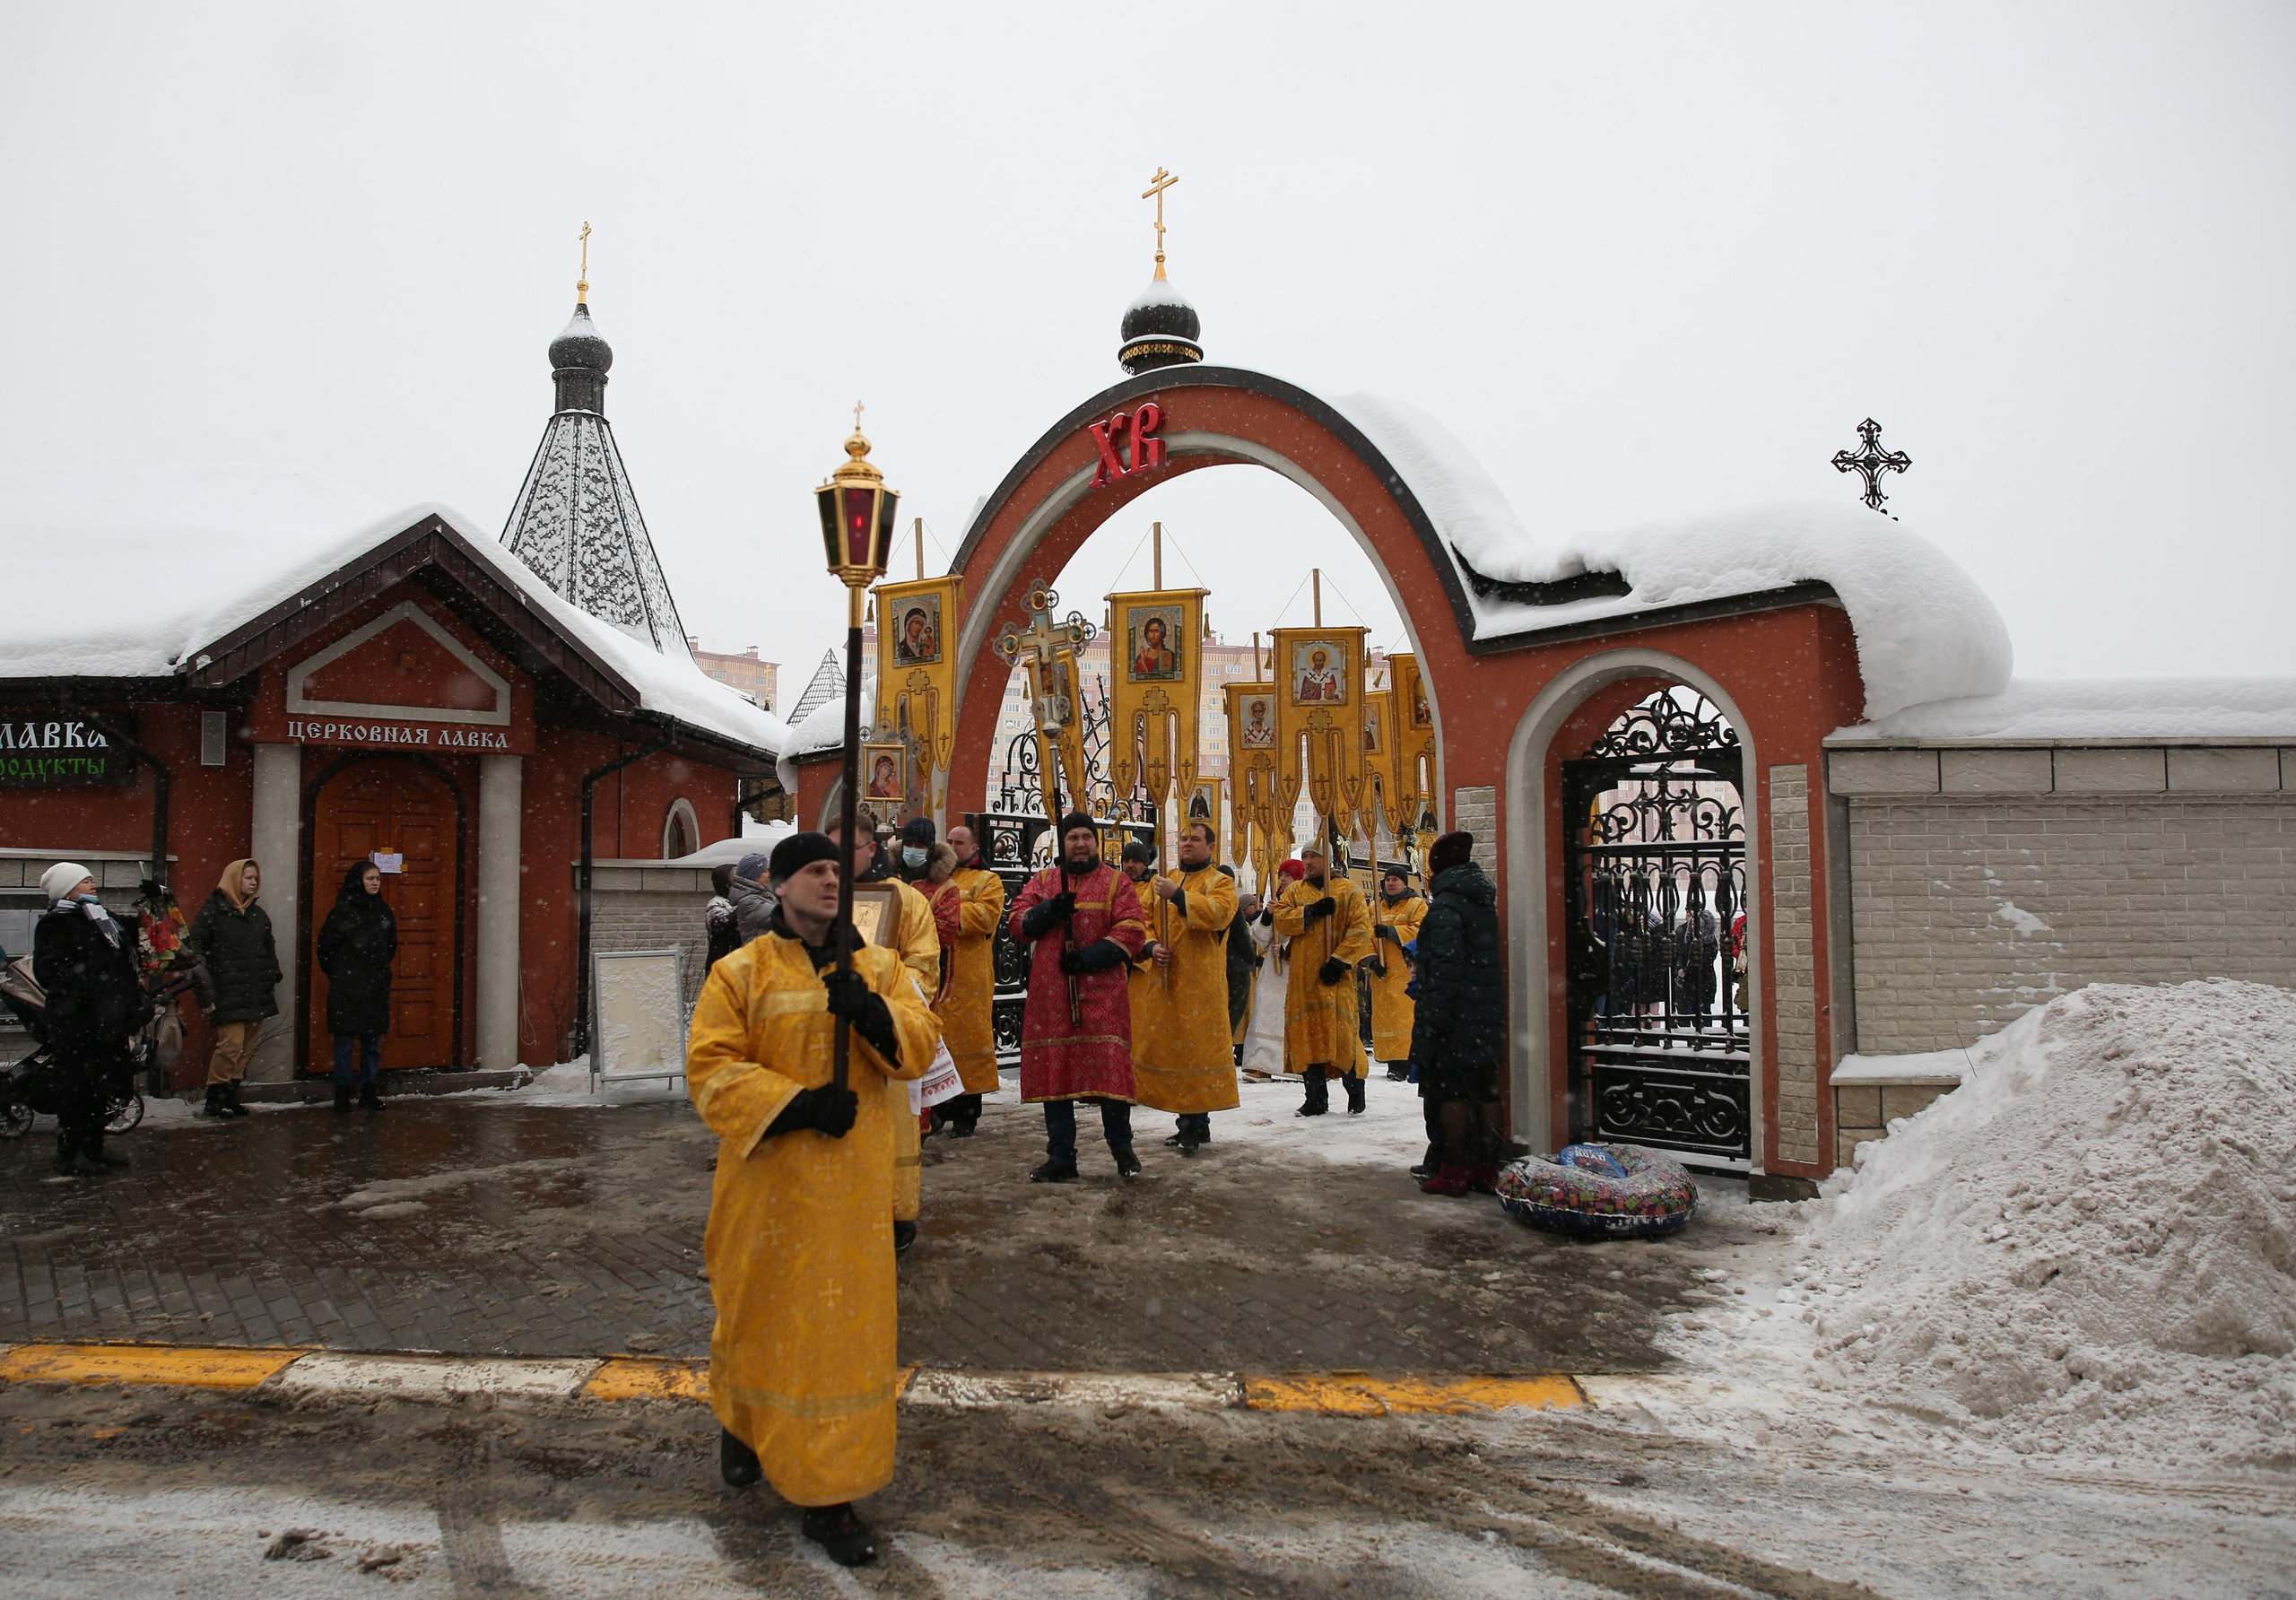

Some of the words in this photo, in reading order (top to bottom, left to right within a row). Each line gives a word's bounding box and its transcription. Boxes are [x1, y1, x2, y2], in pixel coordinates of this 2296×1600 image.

[1087, 402, 1163, 487] ХВ
[286, 720, 430, 744] ЦЕРКОВНАЯ
[437, 729, 509, 749] ЛАВКА
